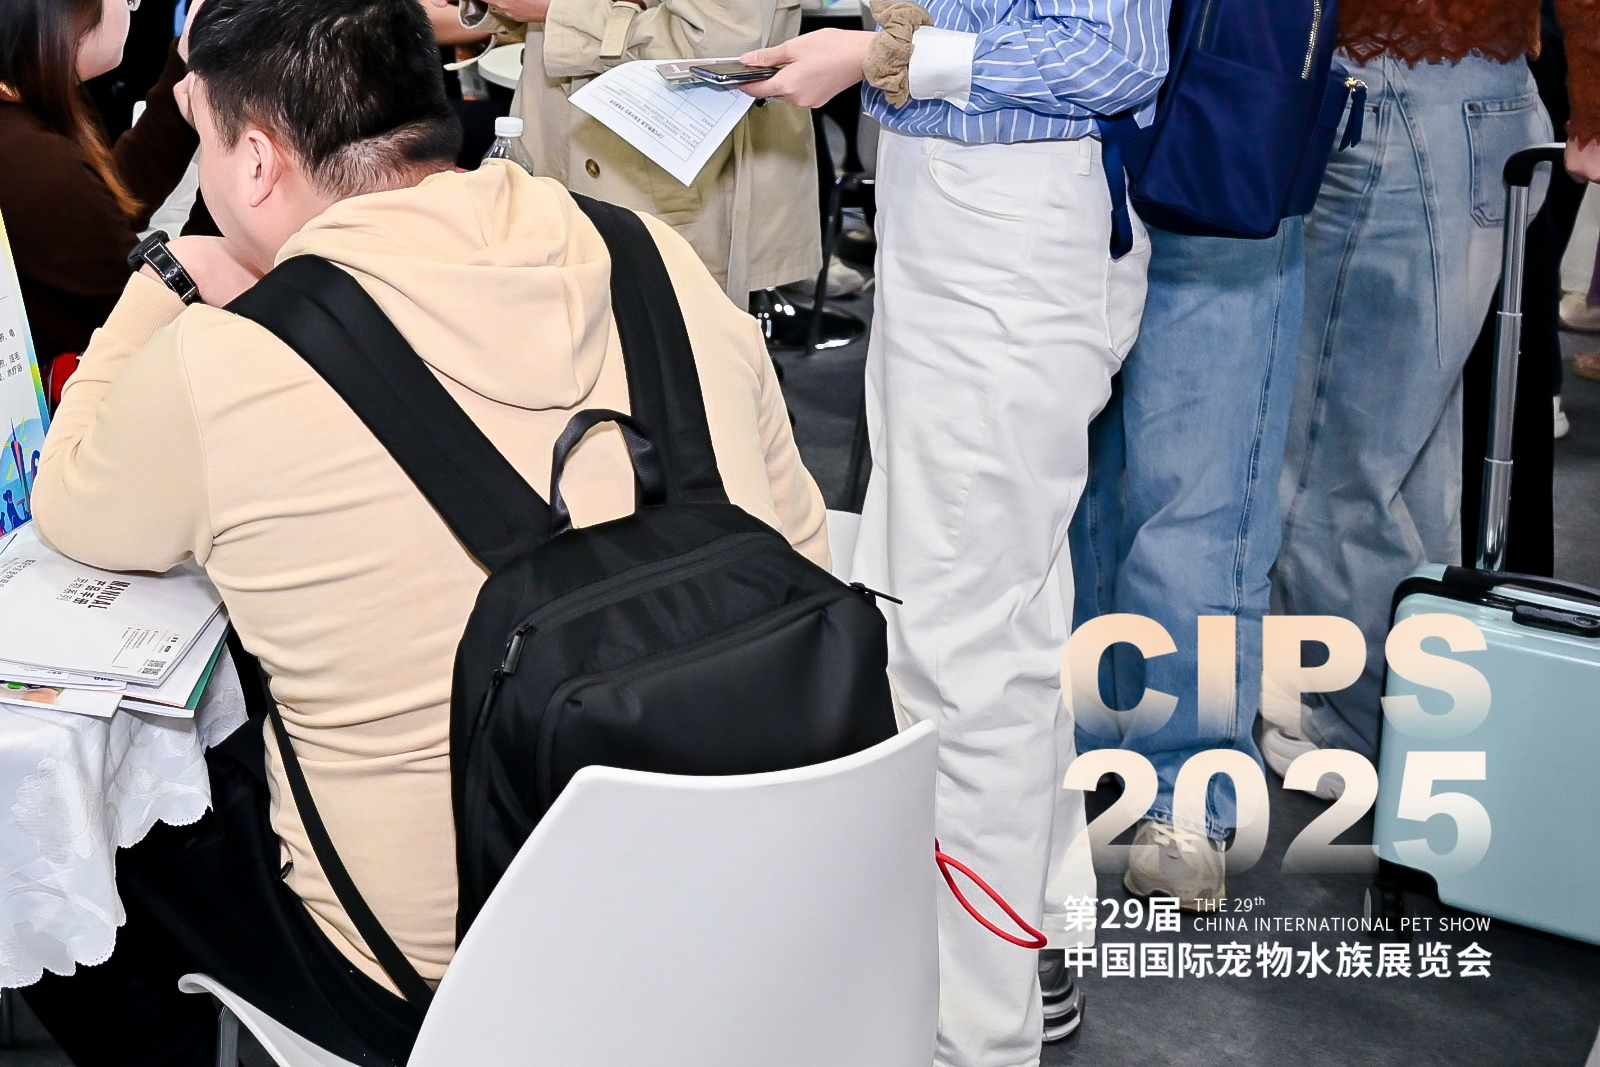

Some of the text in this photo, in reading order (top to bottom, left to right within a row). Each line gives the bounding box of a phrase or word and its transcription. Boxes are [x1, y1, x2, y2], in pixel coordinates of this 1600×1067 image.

[72, 579, 106, 605] 产品手册
[87, 579, 131, 610] MANUAL
